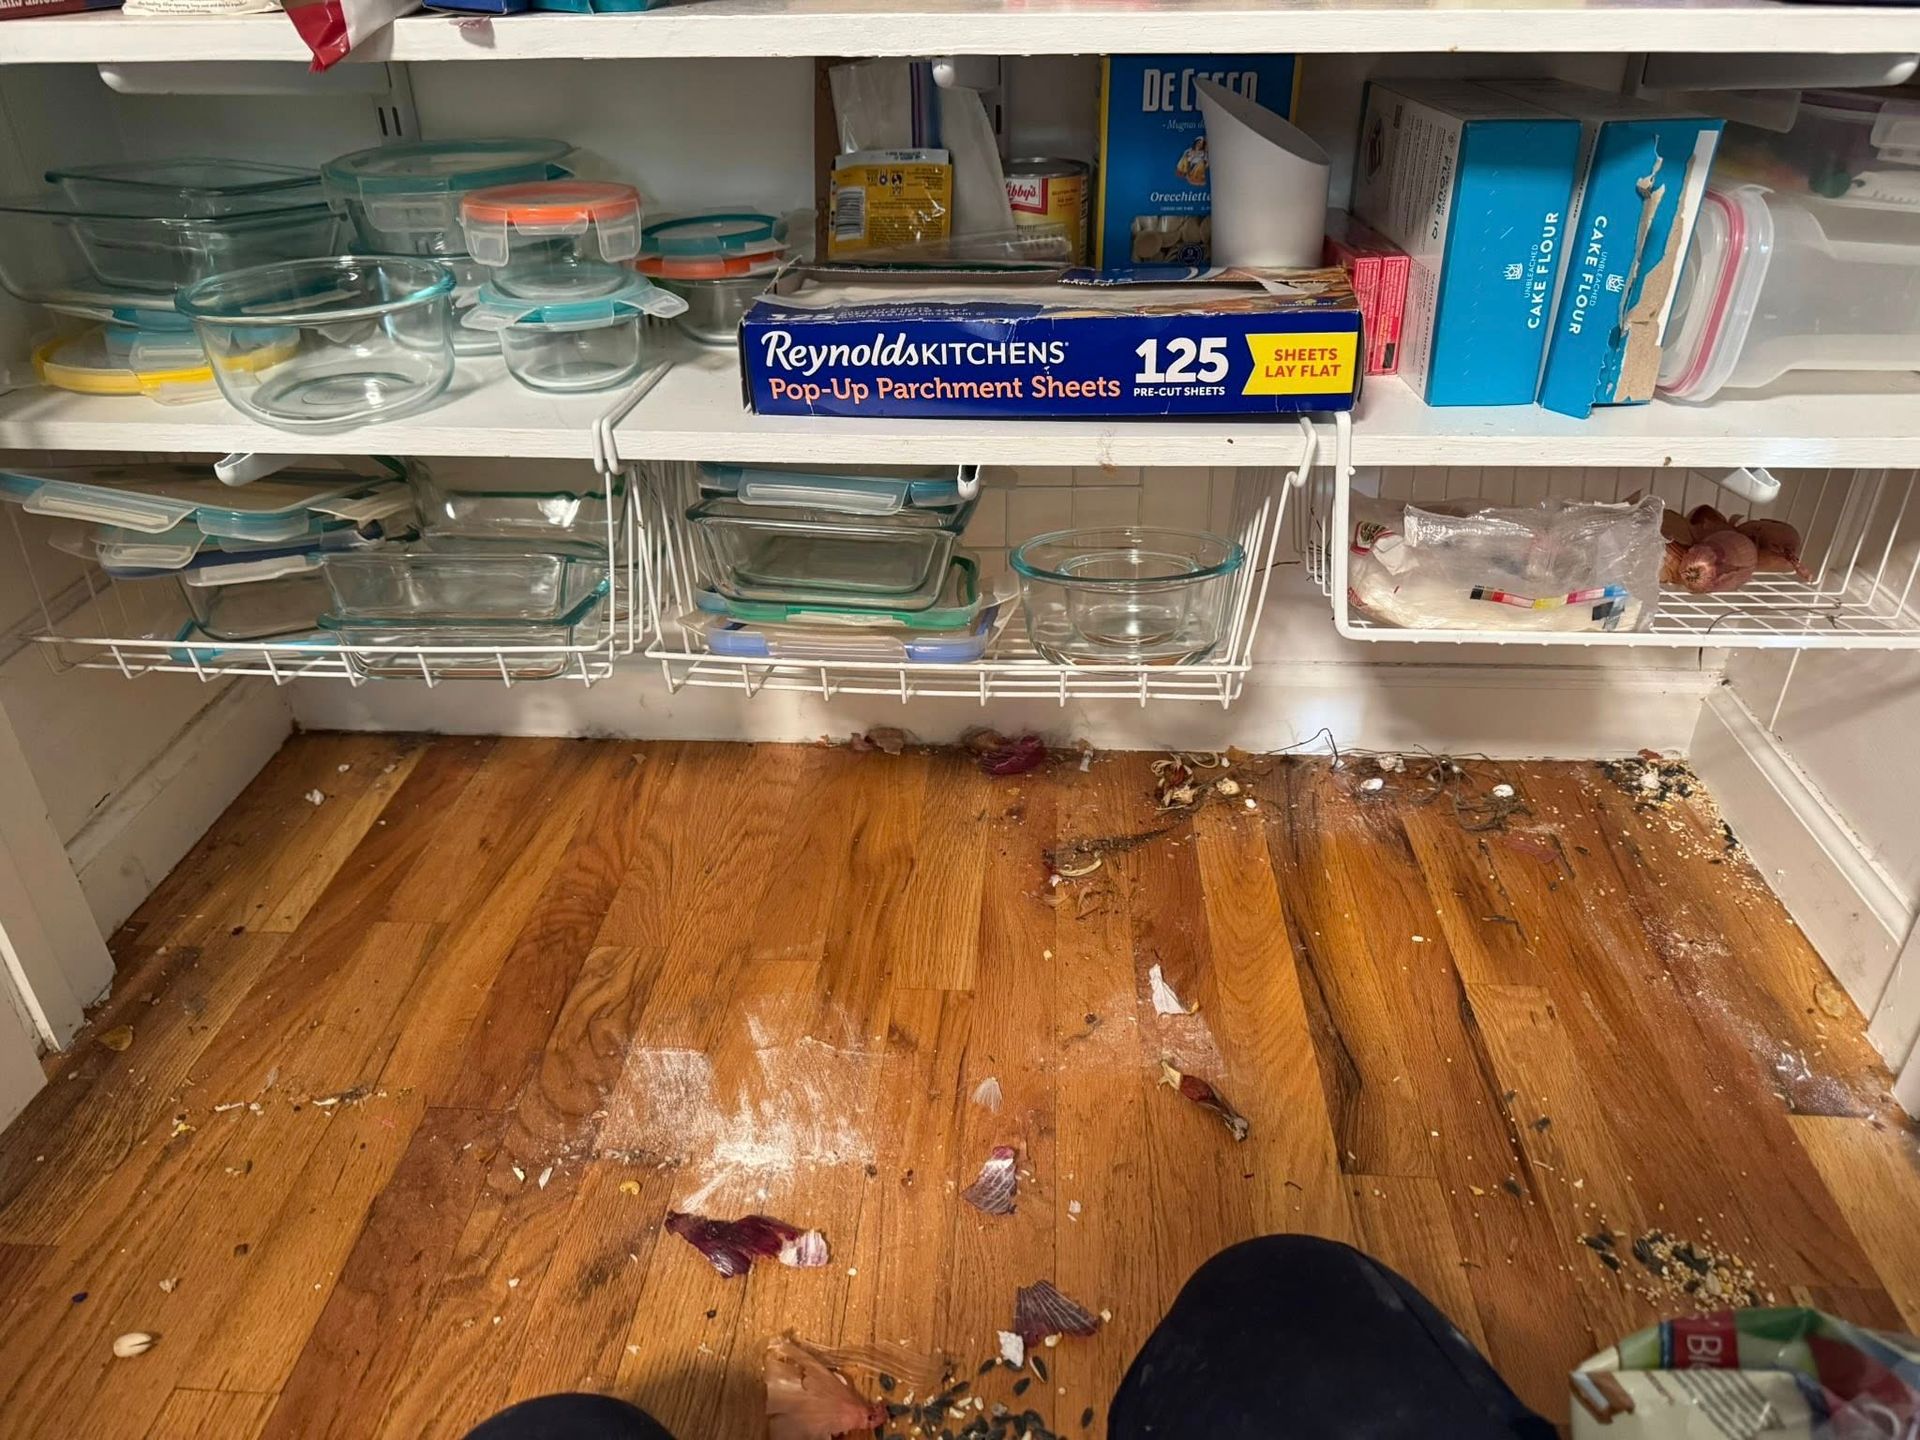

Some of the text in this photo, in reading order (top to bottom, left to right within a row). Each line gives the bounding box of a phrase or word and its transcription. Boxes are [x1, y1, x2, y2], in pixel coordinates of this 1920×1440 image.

[1434, 155, 1450, 215] FLOUR
[1584, 215, 1608, 267] CAKE
[1524, 244, 1538, 298] UNBLEACHED
[1527, 212, 1559, 329] CAKE FLOUR
[1589, 251, 1608, 306] UNBLEACHED
[1568, 273, 1594, 335] FLOUR
[1135, 337, 1229, 384] 125
[1265, 364, 1342, 378] LAY FLAT
[1274, 348, 1338, 361] SHEETS
[768, 374, 1121, 404] Pop-Up Parchment Sheets
[1133, 386, 1226, 397] PRE-CUT SHEETS
